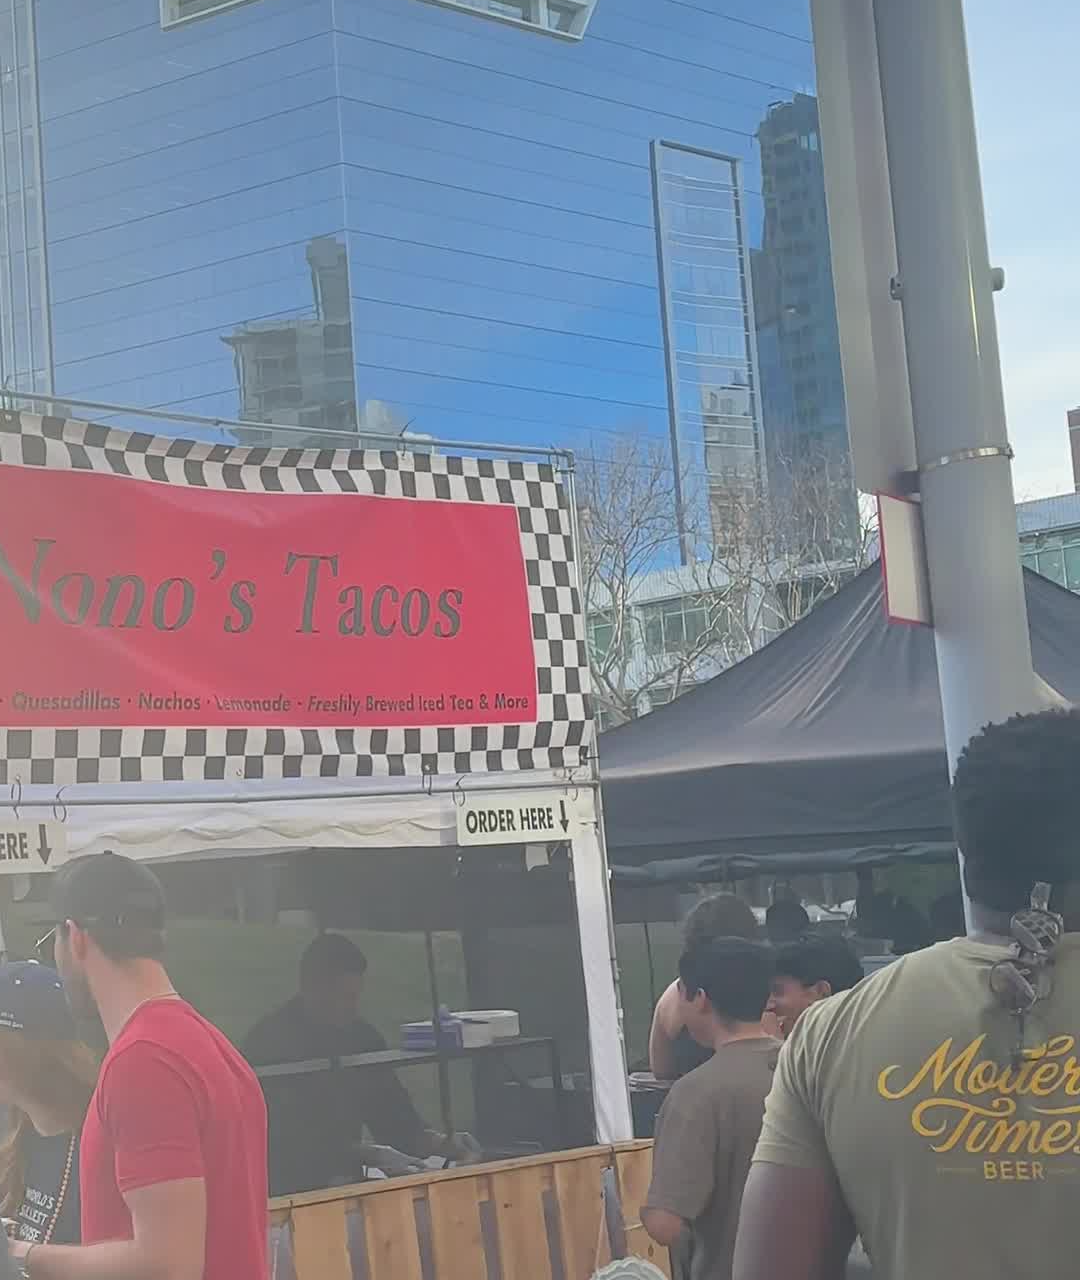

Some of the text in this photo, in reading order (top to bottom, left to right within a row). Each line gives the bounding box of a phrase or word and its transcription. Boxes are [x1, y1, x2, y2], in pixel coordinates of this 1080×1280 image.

[282, 551, 464, 639] Tacos
[12, 689, 121, 711] Quesadillas
[138, 691, 201, 711] Nachos
[215, 694, 291, 712] Lemonade
[308, 695, 360, 716] Freshly
[366, 695, 414, 712] Brewed
[450, 694, 474, 711] Tea
[479, 694, 489, 710] &
[494, 693, 529, 710] More
[466, 807, 554, 834] ORDER HERE
[983, 1160, 1045, 1180] BEER
